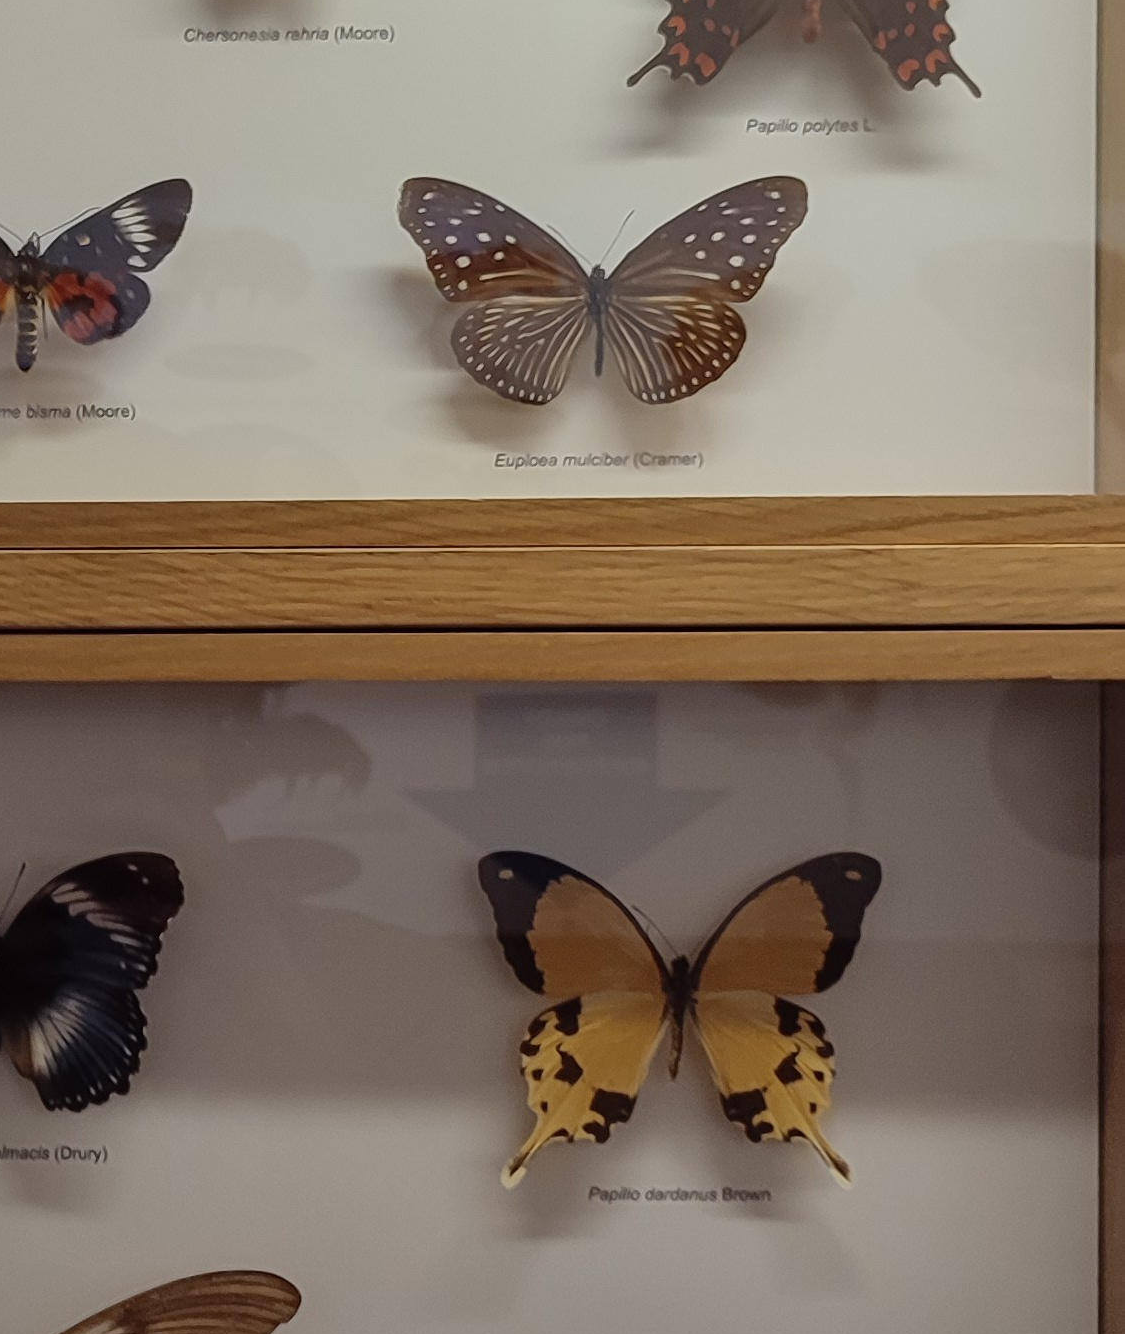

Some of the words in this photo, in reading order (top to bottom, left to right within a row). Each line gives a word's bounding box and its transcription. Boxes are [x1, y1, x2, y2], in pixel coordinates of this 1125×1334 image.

[184, 28, 279, 42] Chersonesia
[335, 26, 394, 43] (Moore)
[746, 119, 797, 134] Papilio
[802, 119, 858, 135] polytes
[863, 119, 876, 132] L.
[26, 405, 71, 419] bisma
[76, 405, 135, 421] (Moore)
[495, 453, 557, 469] Euploea
[563, 453, 628, 466] mulciber
[633, 452, 703, 469] (Cramer)
[54, 1146, 108, 1164] (Drury)
[588, 1187, 640, 1203] Papilio
[645, 1187, 717, 1201] dardanus
[722, 1188, 771, 1201] Brown
